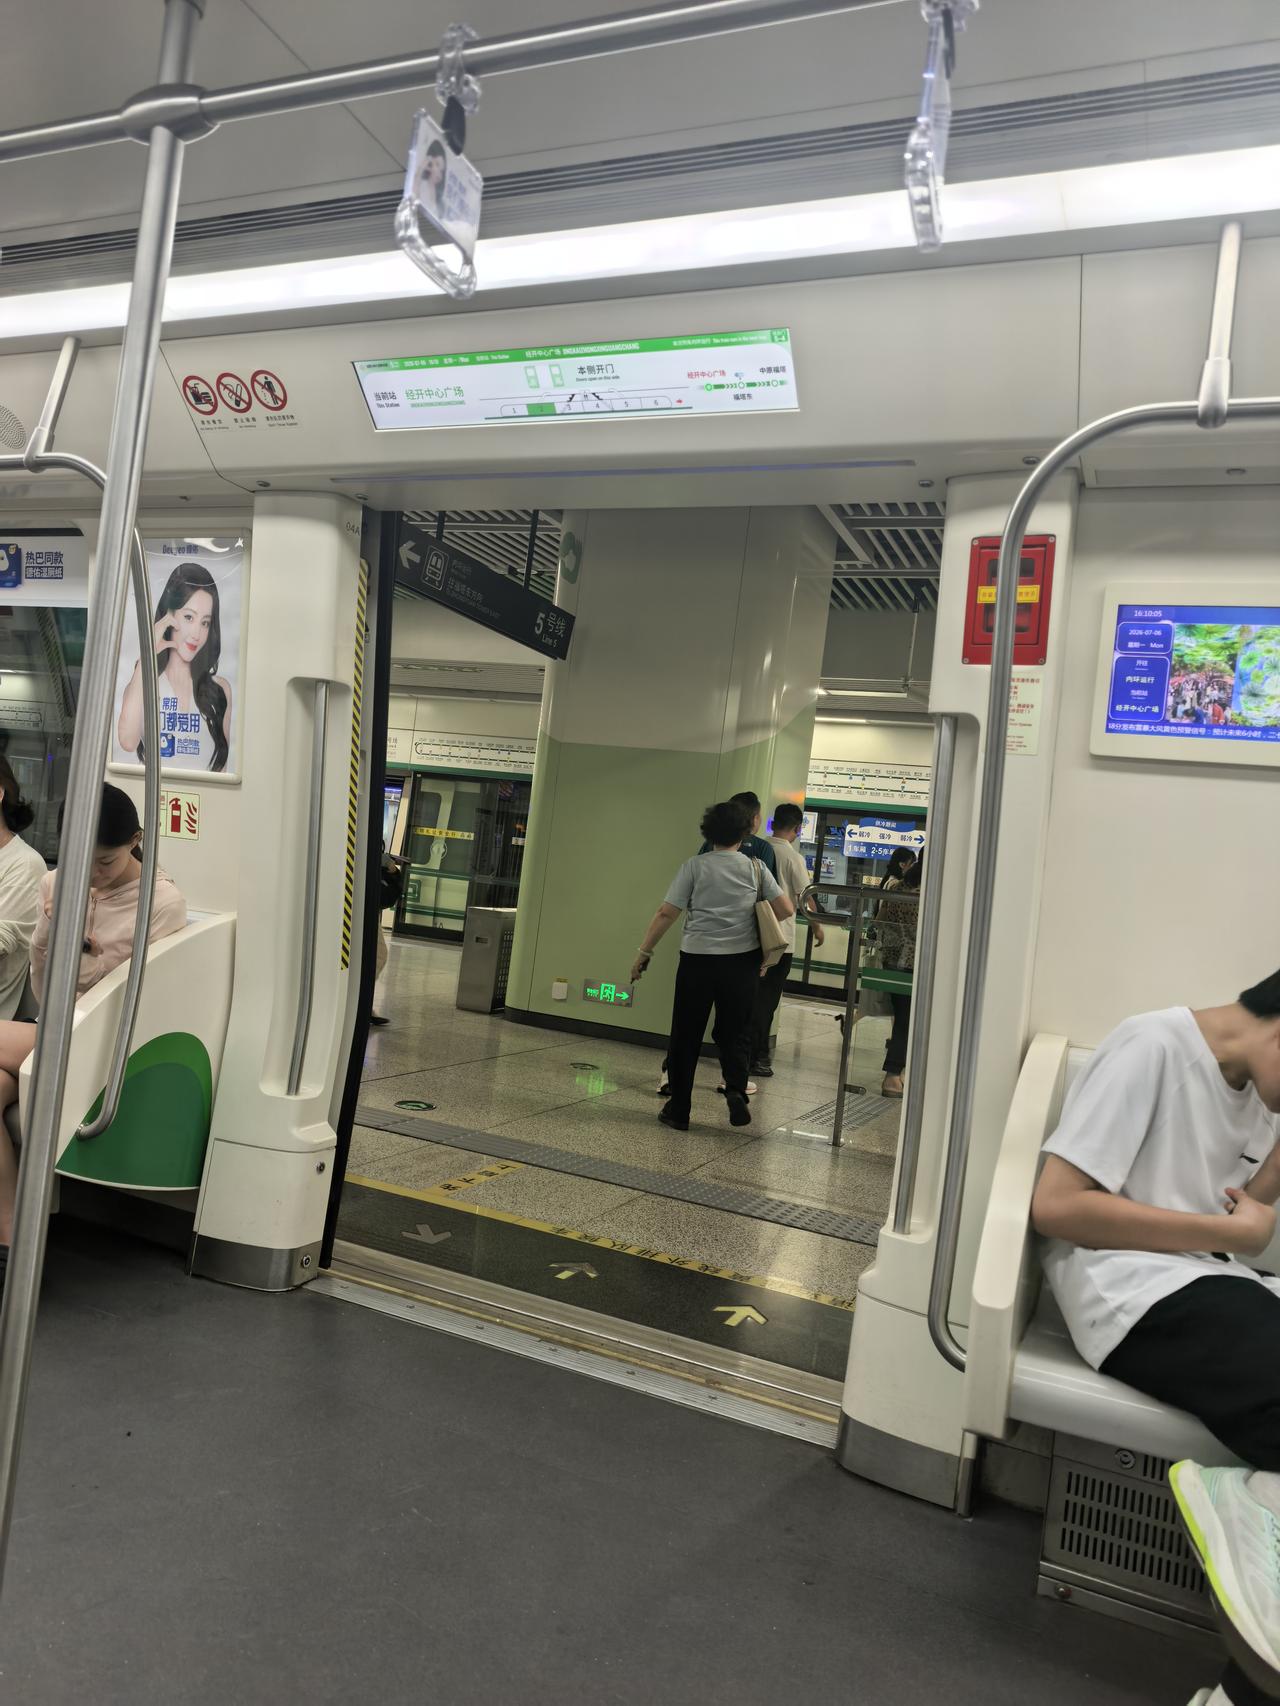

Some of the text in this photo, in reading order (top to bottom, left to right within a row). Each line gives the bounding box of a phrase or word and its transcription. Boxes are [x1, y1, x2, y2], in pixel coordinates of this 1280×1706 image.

[577, 363, 614, 375] 本侧开门
[687, 370, 727, 379] 经开中心广场
[374, 391, 397, 401] 当前站
[405, 386, 465, 400] 经开中心广场
[25, 551, 64, 565] 热巴同款
[1149, 641, 1164, 649] Mon
[1126, 676, 1155, 684] 内环运行
[162, 697, 178, 711] 常用
[1115, 704, 1160, 713] 经开中心广场
